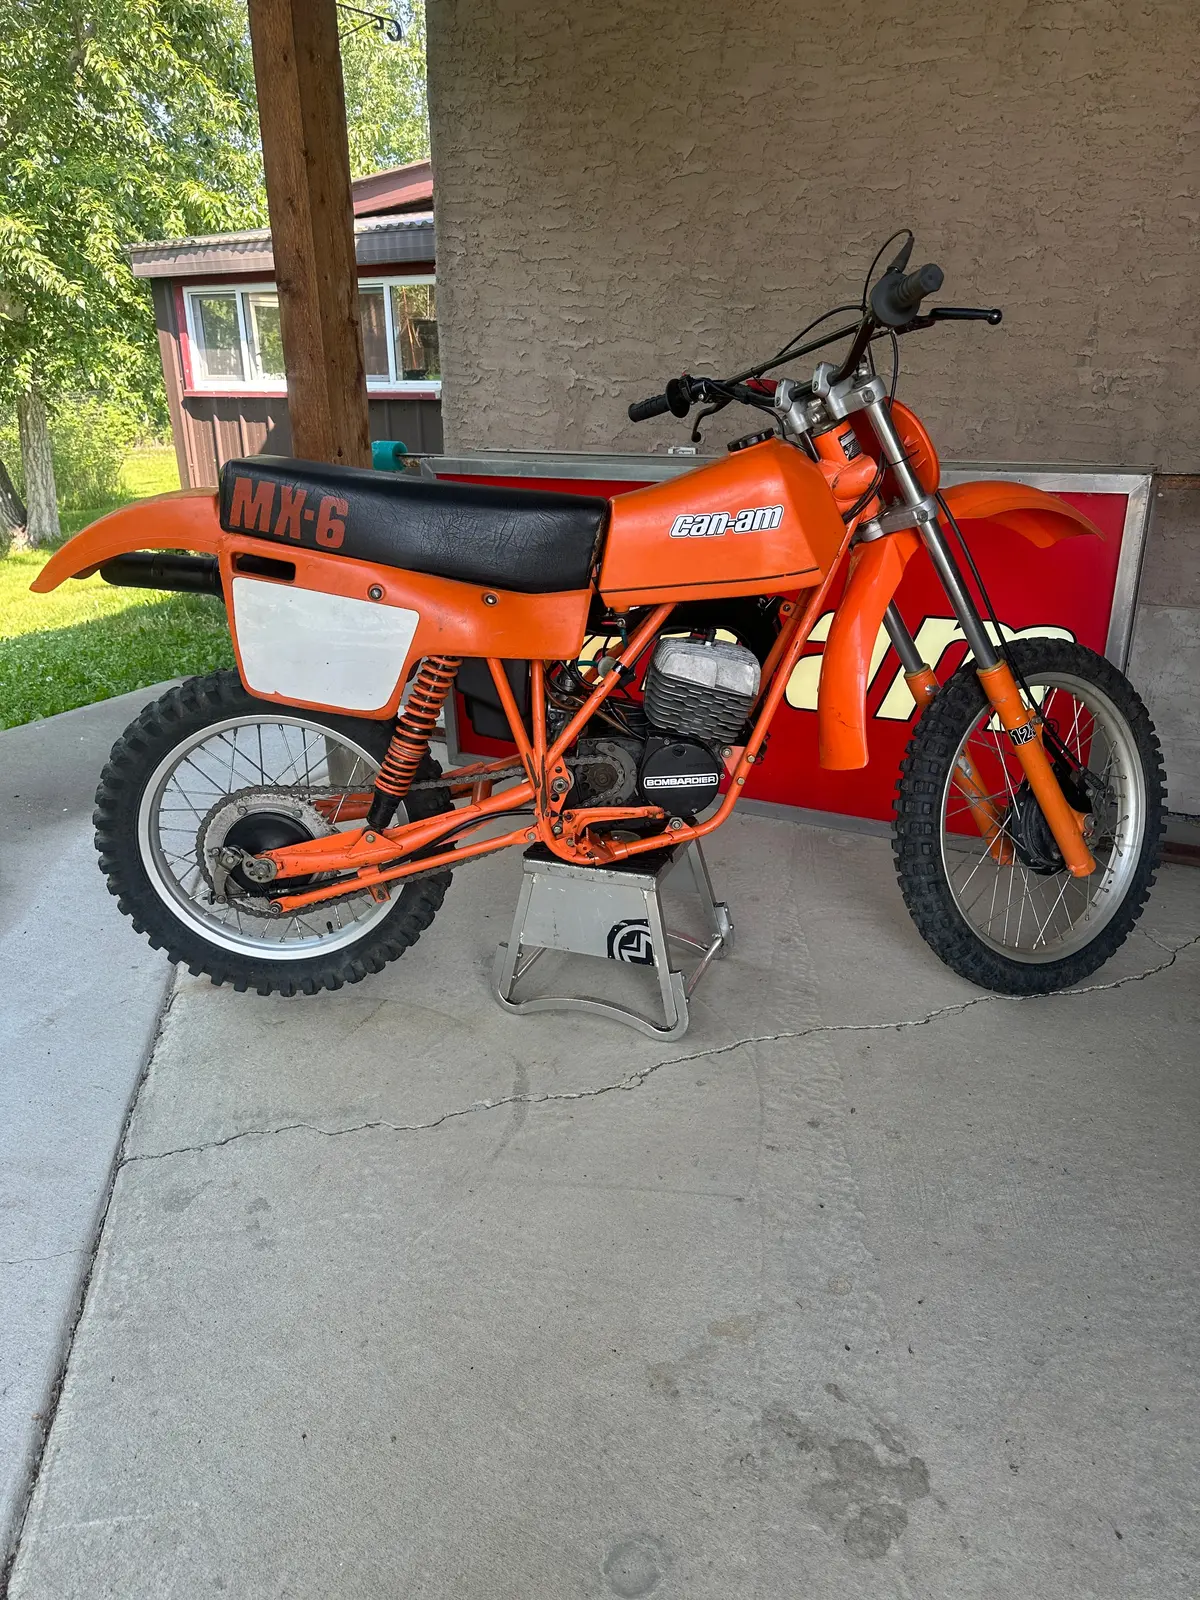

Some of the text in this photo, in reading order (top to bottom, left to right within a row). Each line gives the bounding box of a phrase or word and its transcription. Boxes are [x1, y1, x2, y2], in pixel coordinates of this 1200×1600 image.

[229, 476, 349, 549] MX-6
[670, 505, 784, 538] can-am
[646, 776, 716, 787] BOMBARDIER
